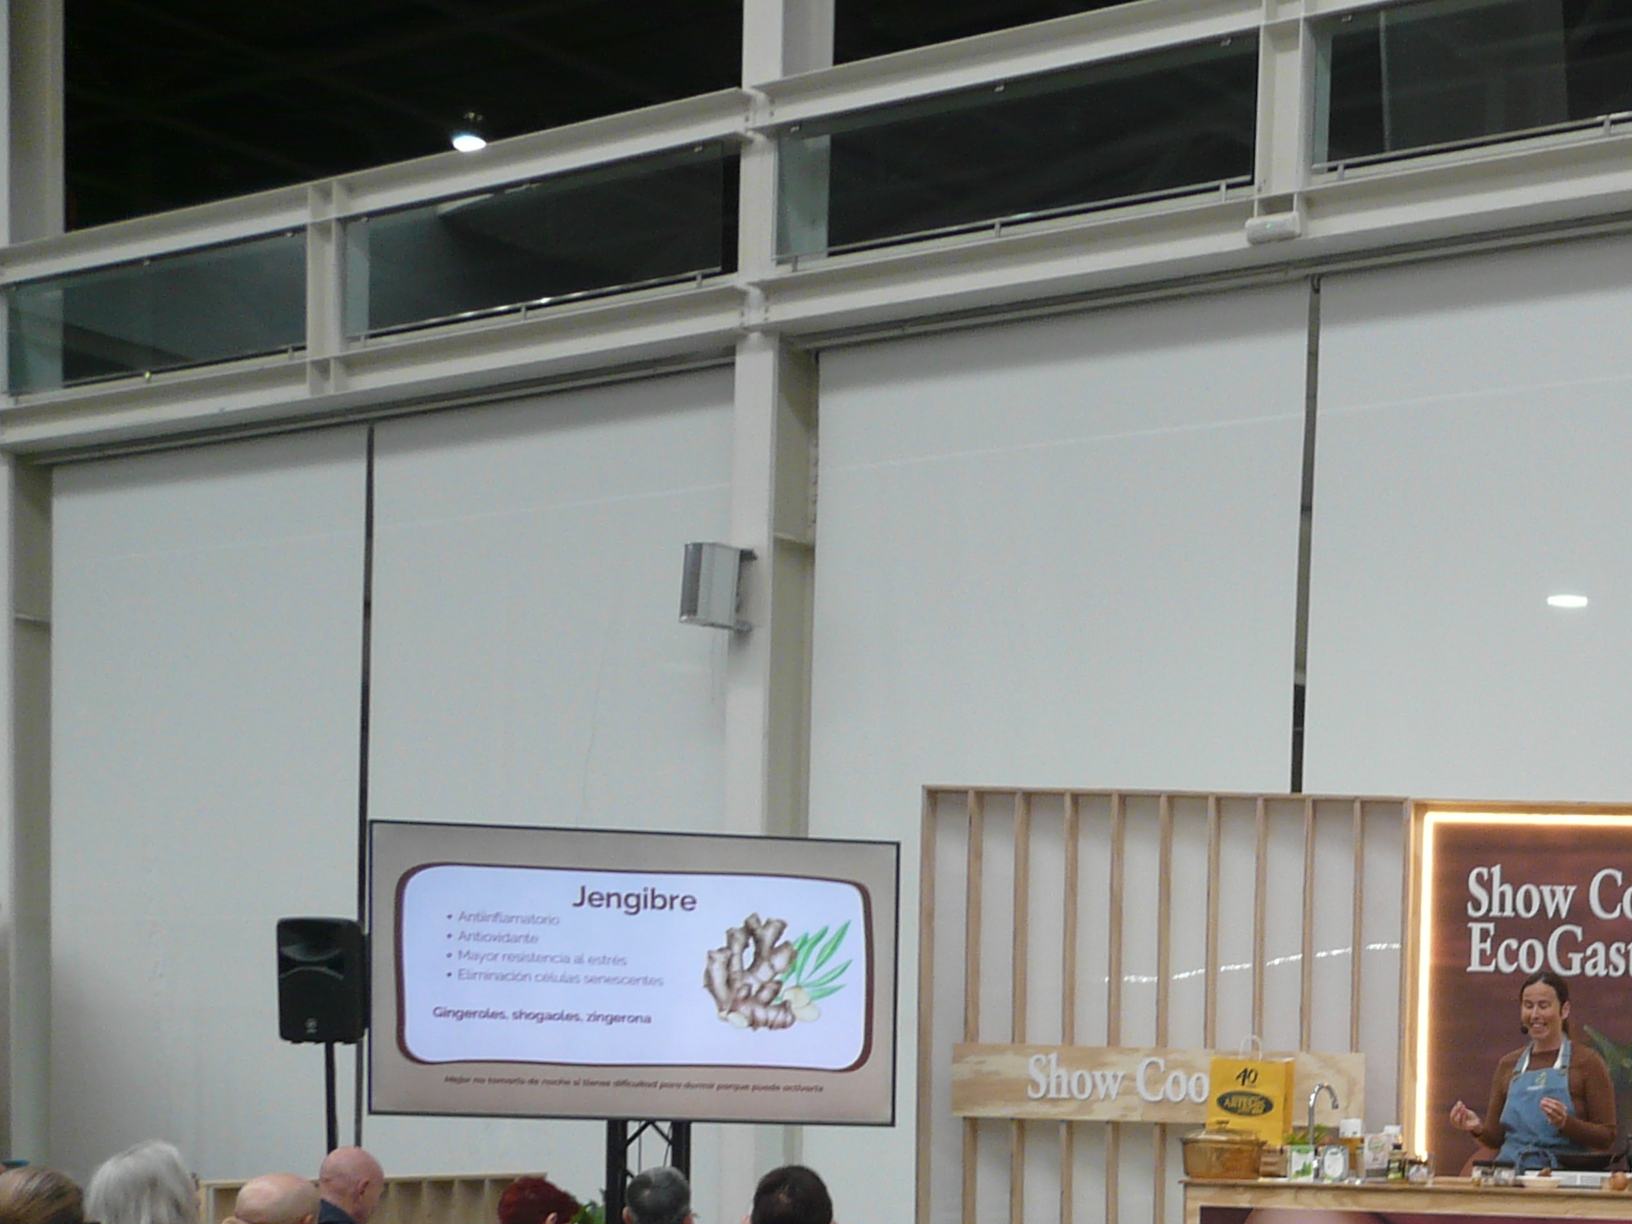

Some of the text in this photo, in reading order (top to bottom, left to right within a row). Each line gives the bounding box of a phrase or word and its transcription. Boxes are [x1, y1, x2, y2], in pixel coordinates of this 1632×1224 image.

[572, 885, 697, 916] Jengibre
[1466, 864, 1577, 920] Show
[457, 930, 539, 944] Antioxidante
[457, 950, 497, 964] Mayor
[501, 951, 570, 964] resistencia
[573, 953, 584, 965] al
[457, 967, 664, 987] Eliminación células senescentes
[586, 1010, 652, 1025] zingerona
[1026, 1052, 1210, 1104] Show Coo
